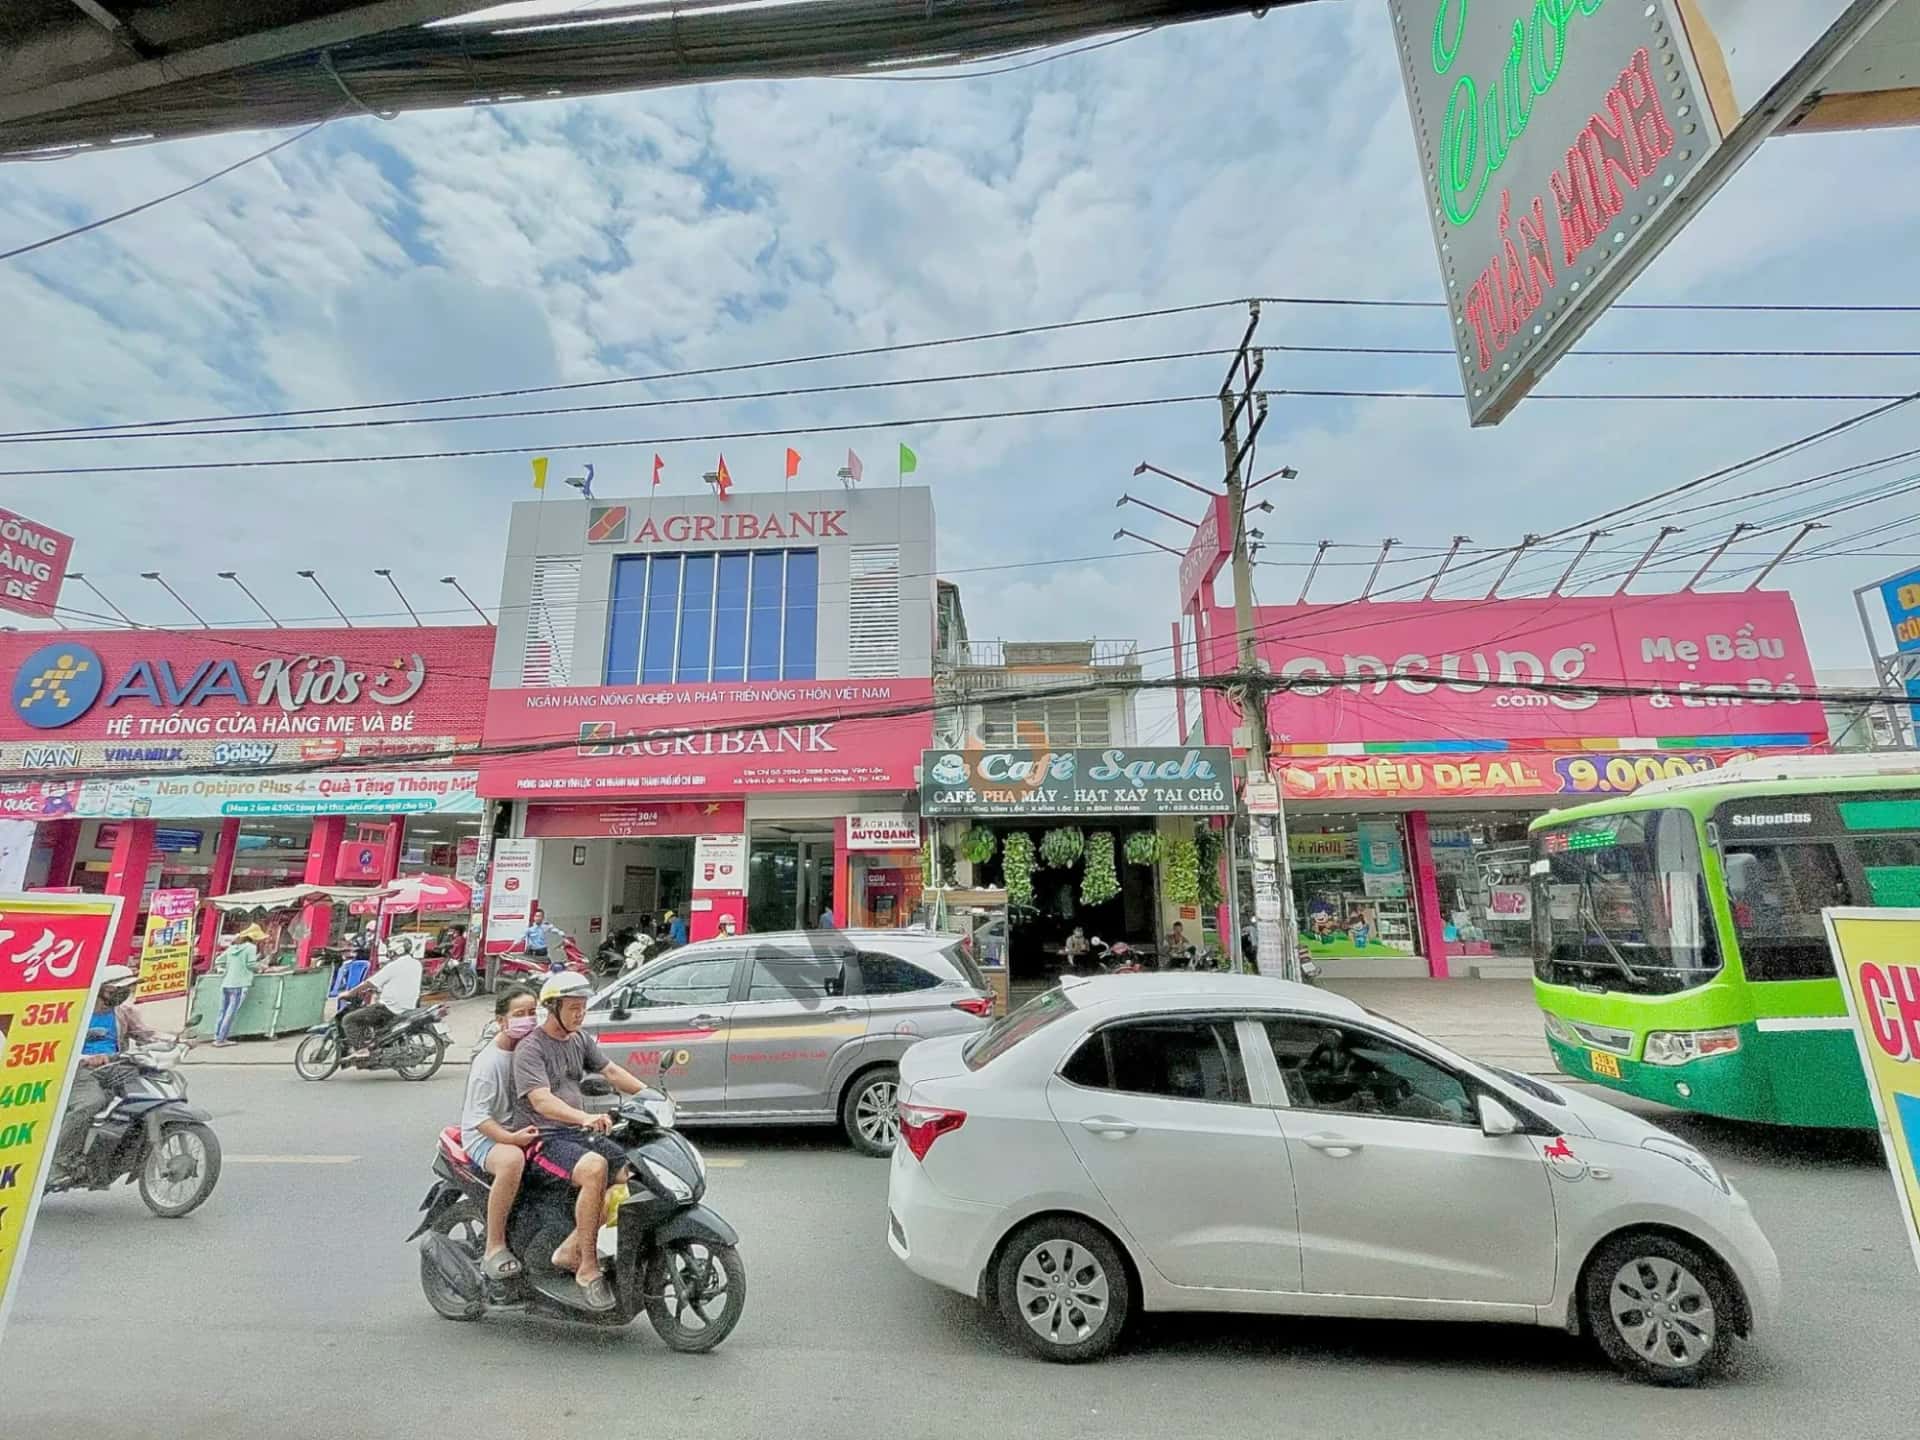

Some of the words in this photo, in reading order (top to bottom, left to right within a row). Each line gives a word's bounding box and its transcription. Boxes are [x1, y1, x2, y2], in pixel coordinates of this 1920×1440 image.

[0, 518, 57, 556] ỐNG
[634, 509, 849, 543] AGRIBANK
[1640, 636, 1700, 671] Mẹ
[1705, 623, 1785, 661] Bầu
[105, 660, 250, 707] AVA
[252, 655, 365, 712] Kids
[527, 693, 560, 708] NGÂN
[564, 692, 597, 707] HÀNG
[600, 691, 634, 706] NÔNG
[635, 691, 674, 706] NGHIỆP
[676, 690, 692, 704] VÀ
[695, 688, 726, 703] PHÁT
[761, 686, 796, 701] NÔNG
[800, 686, 832, 700] THÔN
[834, 685, 860, 700] VIỆT
[862, 687, 891, 699] NAM
[1649, 685, 1674, 708] &
[1491, 694, 1549, 707] .com
[107, 714, 132, 739] HỆ
[139, 709, 211, 735] THỐNG
[215, 713, 257, 734] CỬA
[262, 711, 321, 734] HÀNG
[325, 715, 355, 737] MẸ
[362, 710, 386, 732] VÀ
[390, 709, 416, 733] BÉ
[615, 722, 839, 757] AGRIBANK
[22, 745, 82, 768] NAN
[104, 748, 185, 762] VINAMILK
[977, 752, 1076, 786] Café
[1088, 749, 1217, 787] Sạch
[157, 780, 189, 796] Nan
[192, 779, 256, 799] Optipro
[259, 780, 290, 794] Plus
[294, 780, 306, 793] 4
[319, 778, 351, 797] Quà
[355, 777, 394, 797] Tặng
[398, 775, 448, 794] Thông
[1320, 757, 1425, 797] TRIỆU
[1432, 760, 1542, 791] DEAL
[933, 787, 977, 803] CAFÉ
[982, 790, 1017, 803] PHA
[1074, 788, 1109, 805] HẠT
[1114, 788, 1149, 802] XAY
[1153, 788, 1183, 804] TẠI
[1188, 782, 1224, 801] CHỖ
[863, 819, 916, 829] AGRIBANK
[1731, 811, 1812, 826] SaigonBus
[851, 830, 917, 840] AUTOBANK
[21, 1001, 74, 1027] 35K
[6, 1040, 61, 1068] 35K
[0, 1079, 52, 1108] 40K
